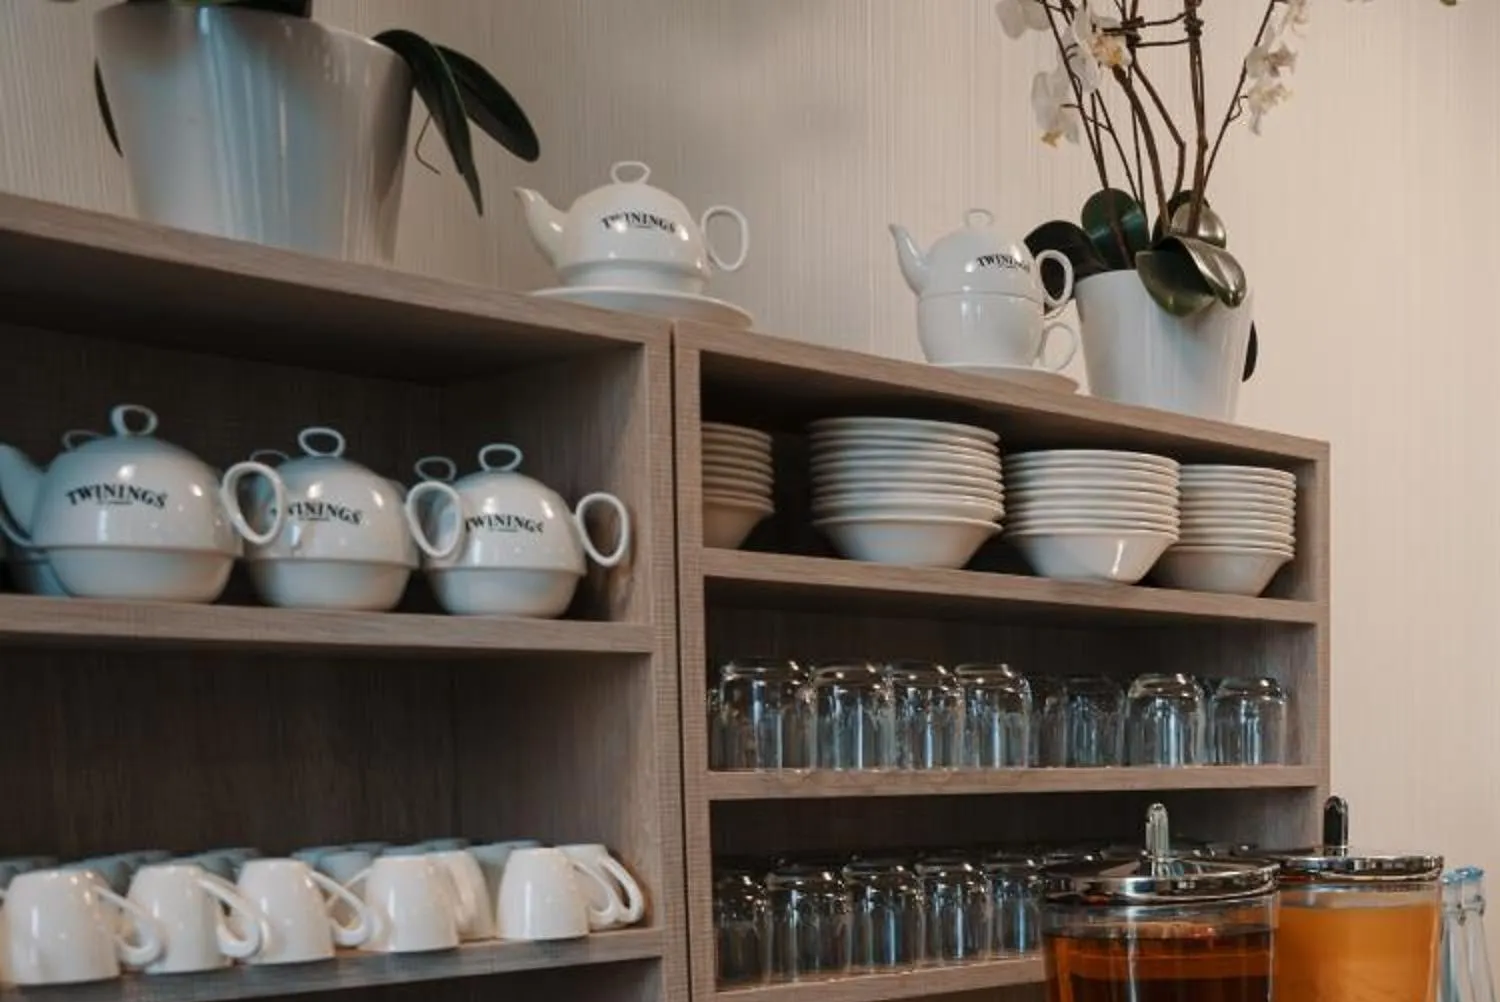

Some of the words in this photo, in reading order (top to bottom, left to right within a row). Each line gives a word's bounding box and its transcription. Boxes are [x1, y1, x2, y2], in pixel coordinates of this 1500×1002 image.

[976, 254, 1031, 274] TWINI
[65, 483, 168, 509] TWININGS
[286, 500, 363, 525] ININGS
